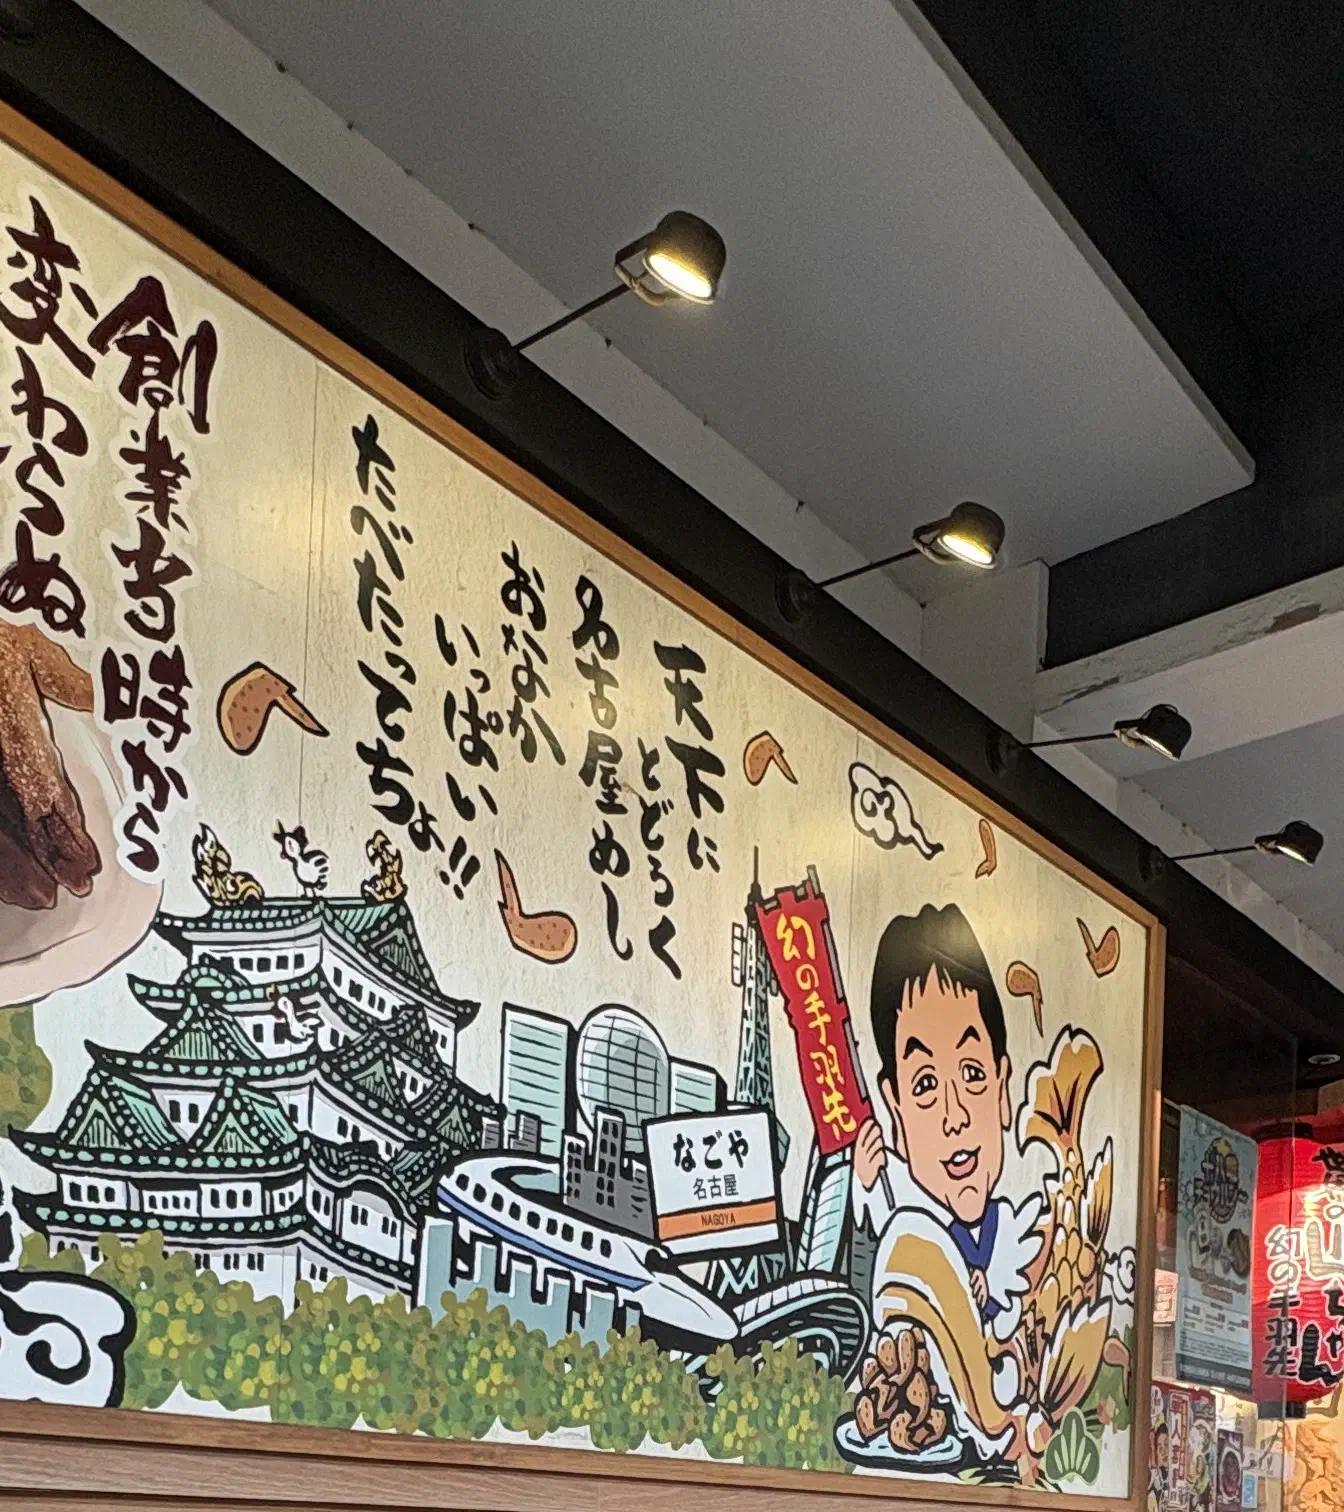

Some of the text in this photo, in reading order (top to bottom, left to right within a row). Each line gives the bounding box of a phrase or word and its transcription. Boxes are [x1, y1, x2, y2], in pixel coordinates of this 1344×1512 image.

[87, 275, 217, 872] 創業当時から
[501, 541, 565, 764] おなか
[435, 614, 499, 820] いっぱい
[654, 641, 725, 873] 天下に
[777, 913, 856, 1140] 幻の手羽先
[673, 1129, 749, 1172] なごや
[693, 1174, 739, 1200] 名古屋
[701, 1212, 736, 1226] NAGOYA
